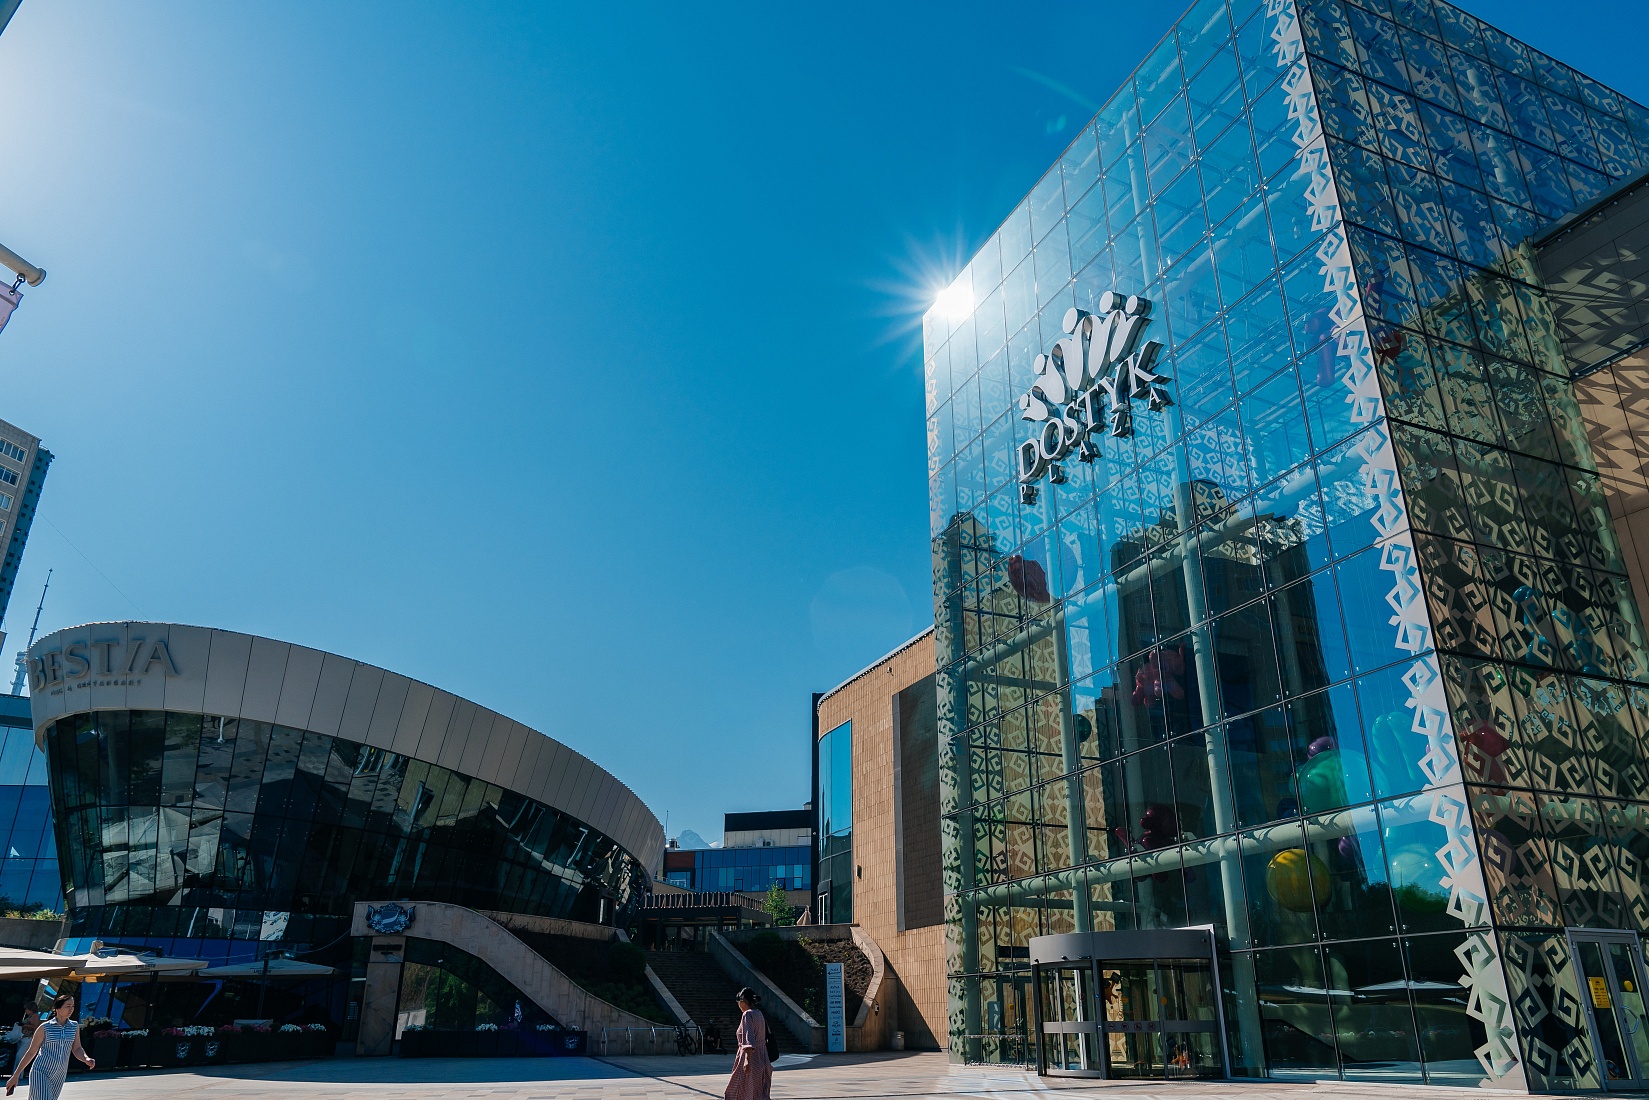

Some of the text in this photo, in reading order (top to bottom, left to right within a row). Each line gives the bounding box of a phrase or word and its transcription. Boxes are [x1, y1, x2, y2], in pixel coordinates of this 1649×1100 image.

[1018, 341, 1171, 483] DOSTYK
[1021, 387, 1173, 504] PLAZA
[28, 640, 180, 692] BESTIA
